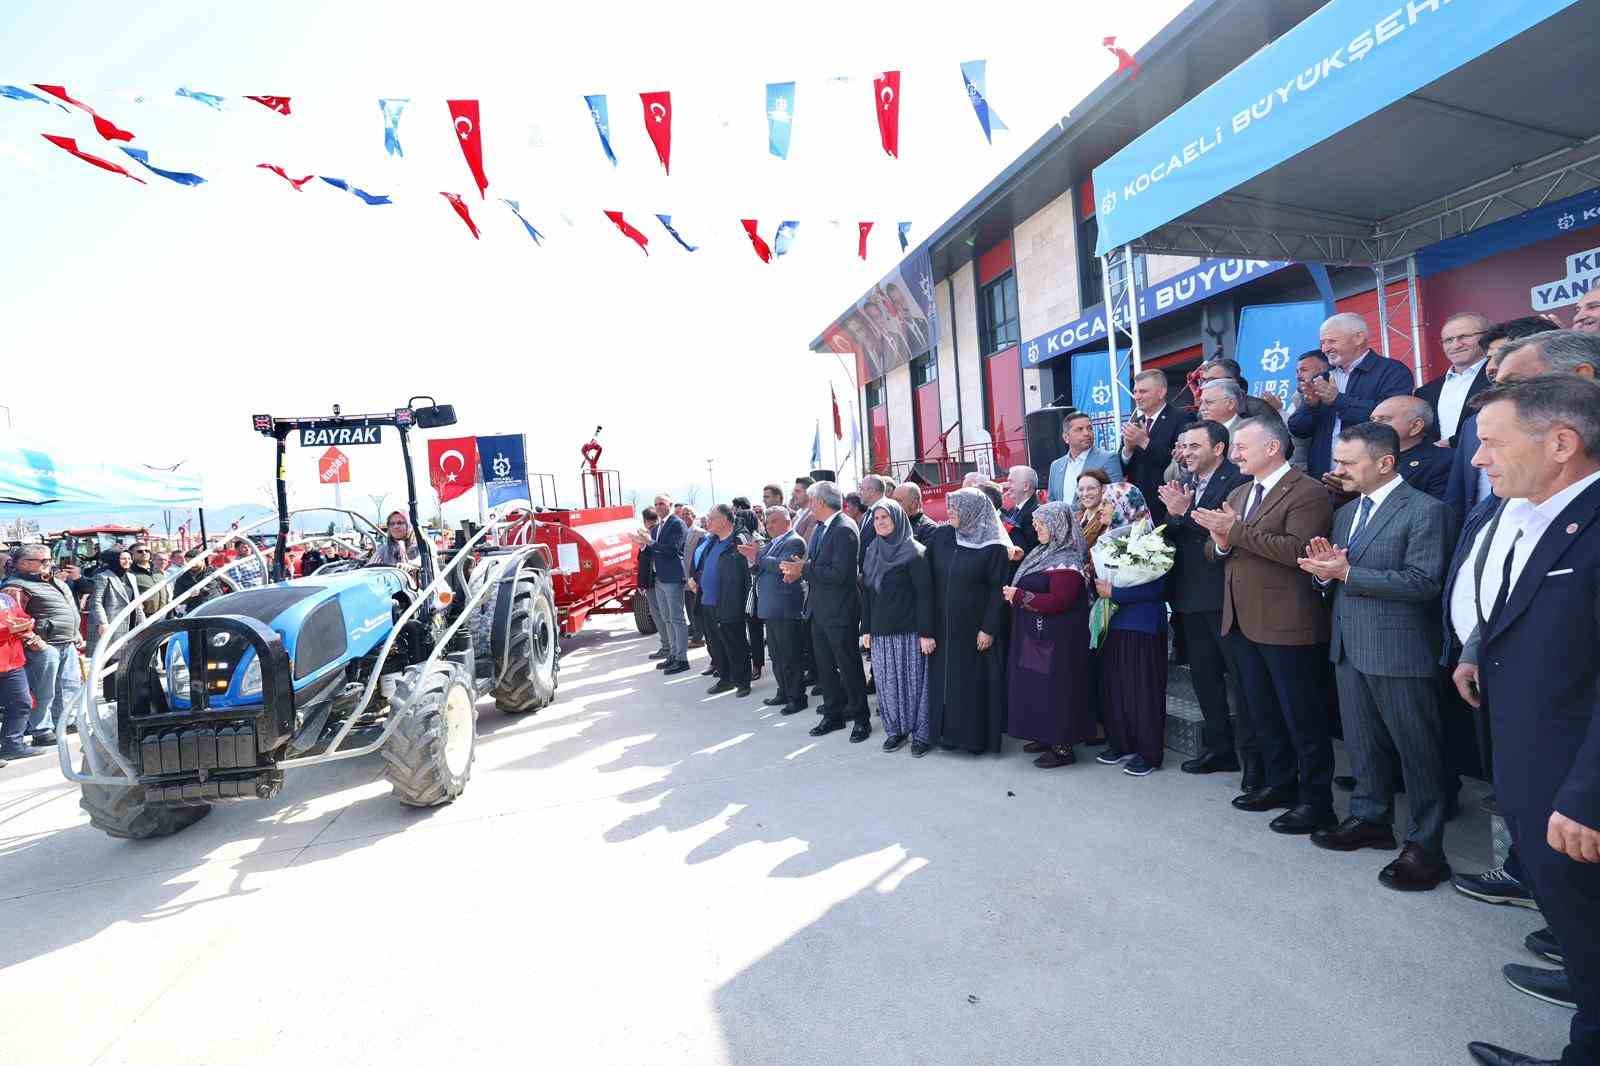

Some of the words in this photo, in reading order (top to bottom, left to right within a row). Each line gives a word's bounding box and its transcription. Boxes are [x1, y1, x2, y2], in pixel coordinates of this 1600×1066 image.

[1123, 125, 1223, 200] KOCAELİ
[1232, 0, 1453, 135] BÜYÜKŞEH
[303, 427, 377, 446] BAYRAK
